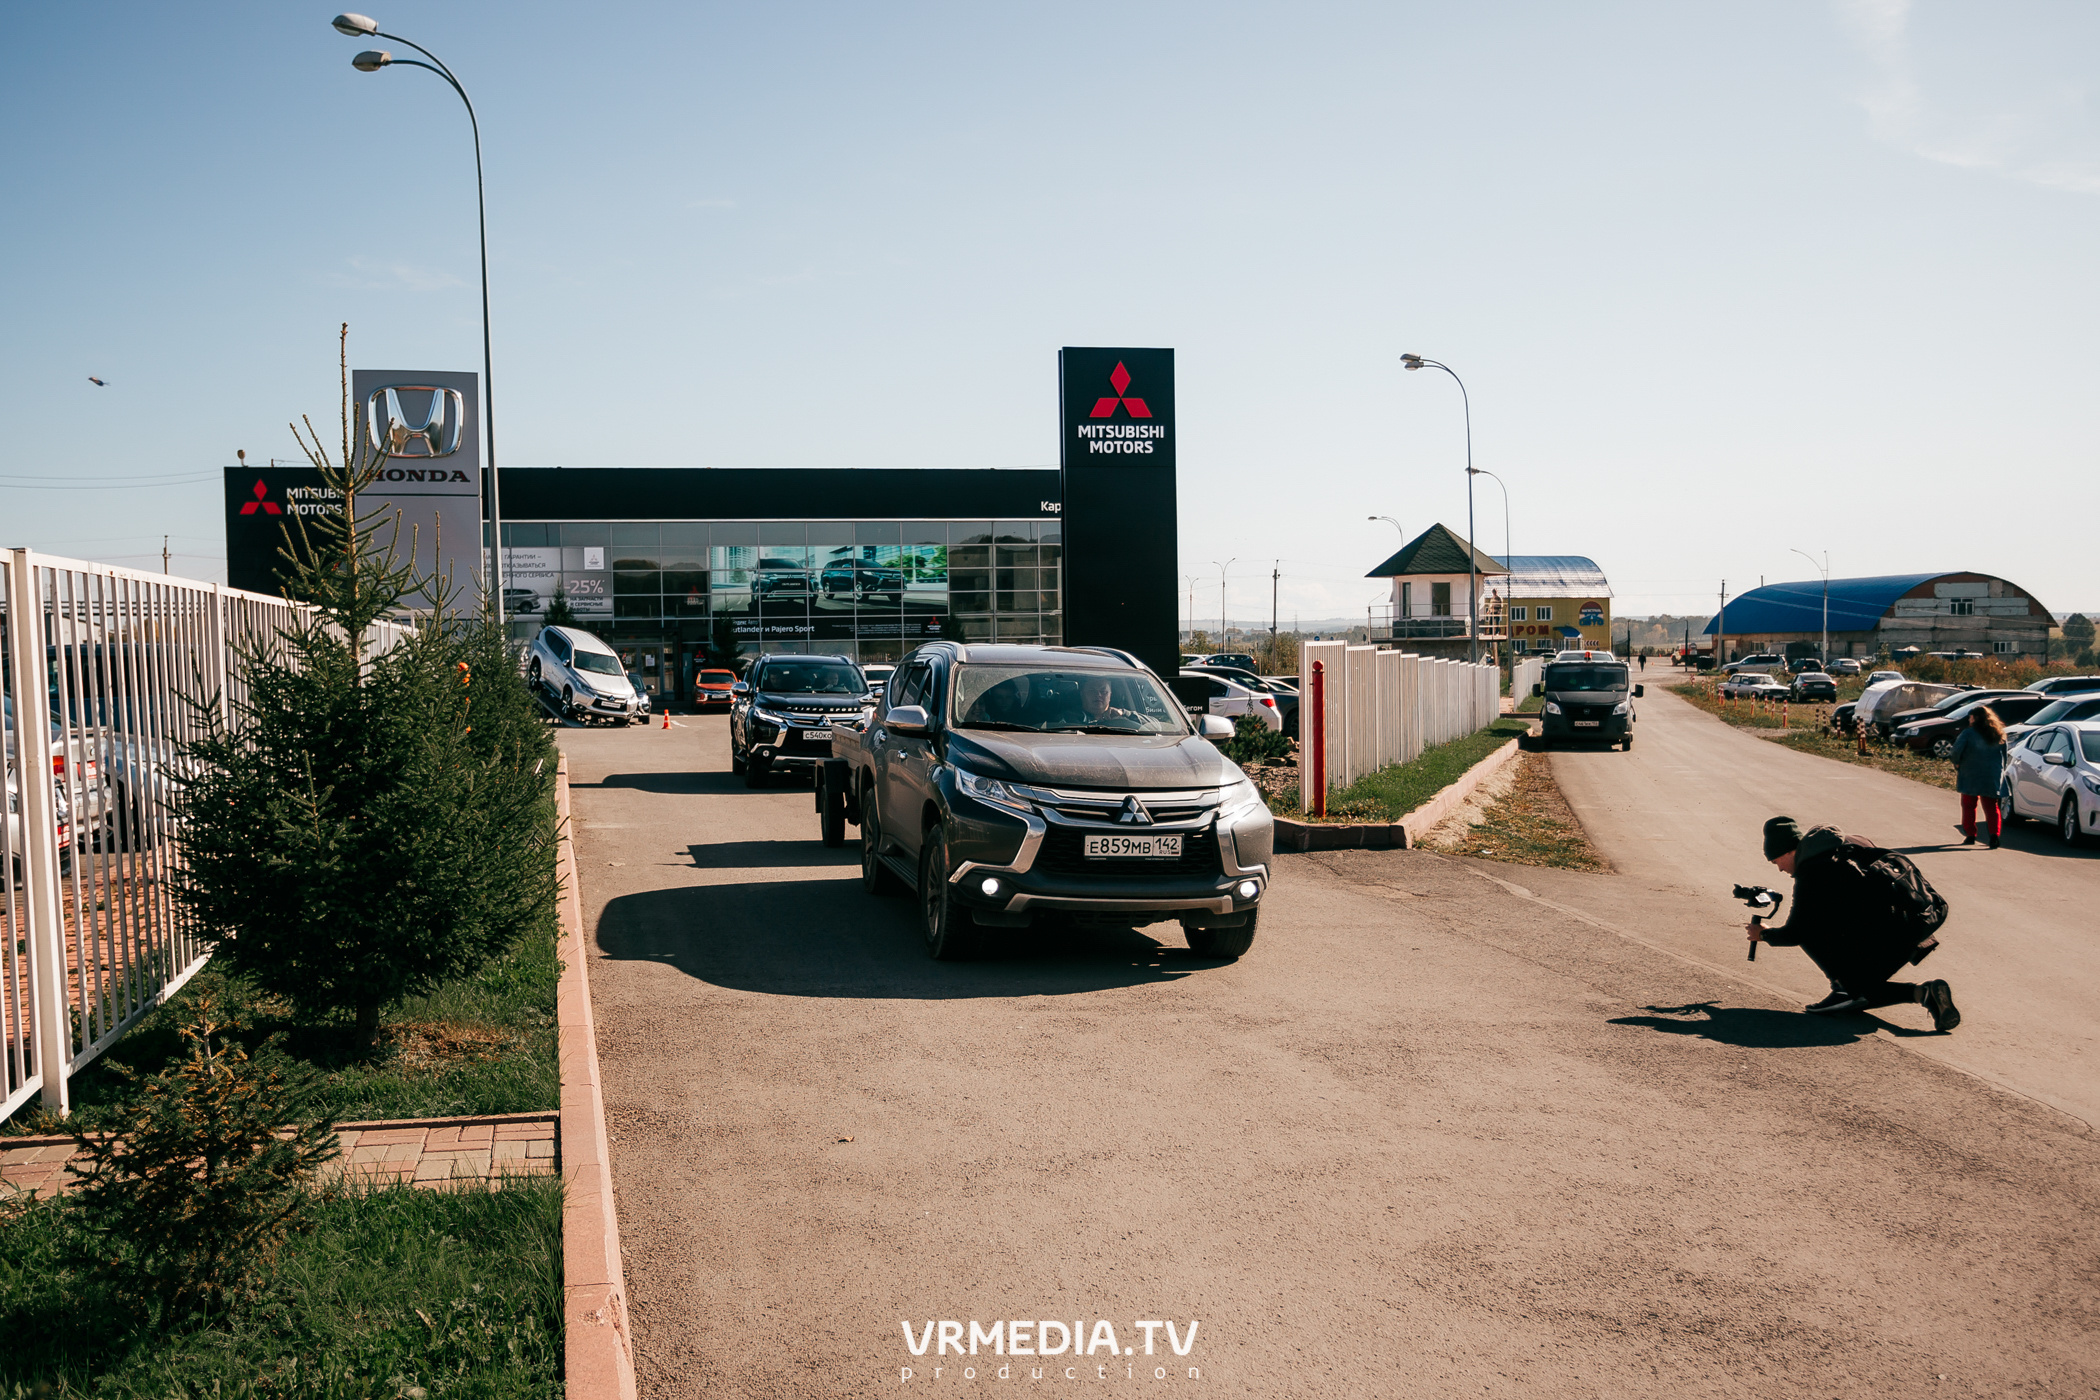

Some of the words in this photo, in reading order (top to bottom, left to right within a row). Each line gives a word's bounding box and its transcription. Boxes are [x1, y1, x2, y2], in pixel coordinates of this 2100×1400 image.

[1077, 425, 1165, 438] MITSUBISHI
[1089, 440, 1154, 454] MOTORS
[365, 469, 471, 483] HONDA
[771, 626, 793, 634] Pajero
[794, 626, 815, 635] Sport
[1155, 837, 1178, 850] 142
